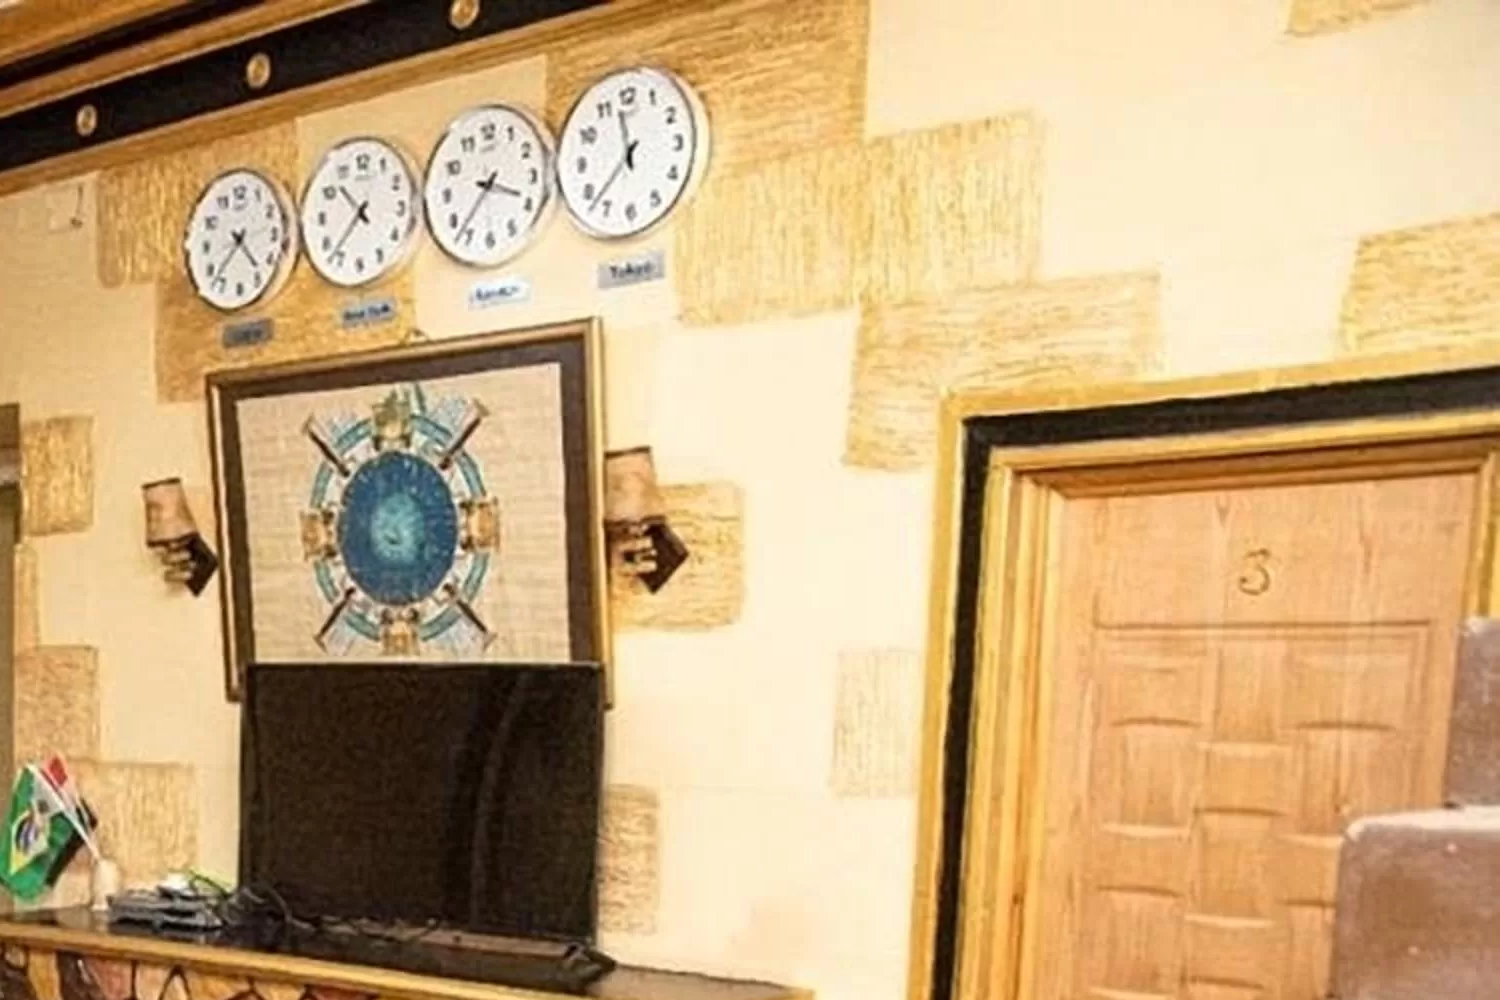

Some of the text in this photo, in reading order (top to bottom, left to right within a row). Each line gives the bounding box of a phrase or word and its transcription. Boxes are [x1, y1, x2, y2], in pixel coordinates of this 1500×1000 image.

[619, 87, 636, 105] 12
[649, 89, 656, 106] 1
[597, 101, 612, 118] 11
[665, 106, 676, 124] 2
[580, 126, 597, 144] 10
[673, 133, 684, 151] 3
[602, 200, 612, 217] 7
[1239, 548, 1271, 596] 3
